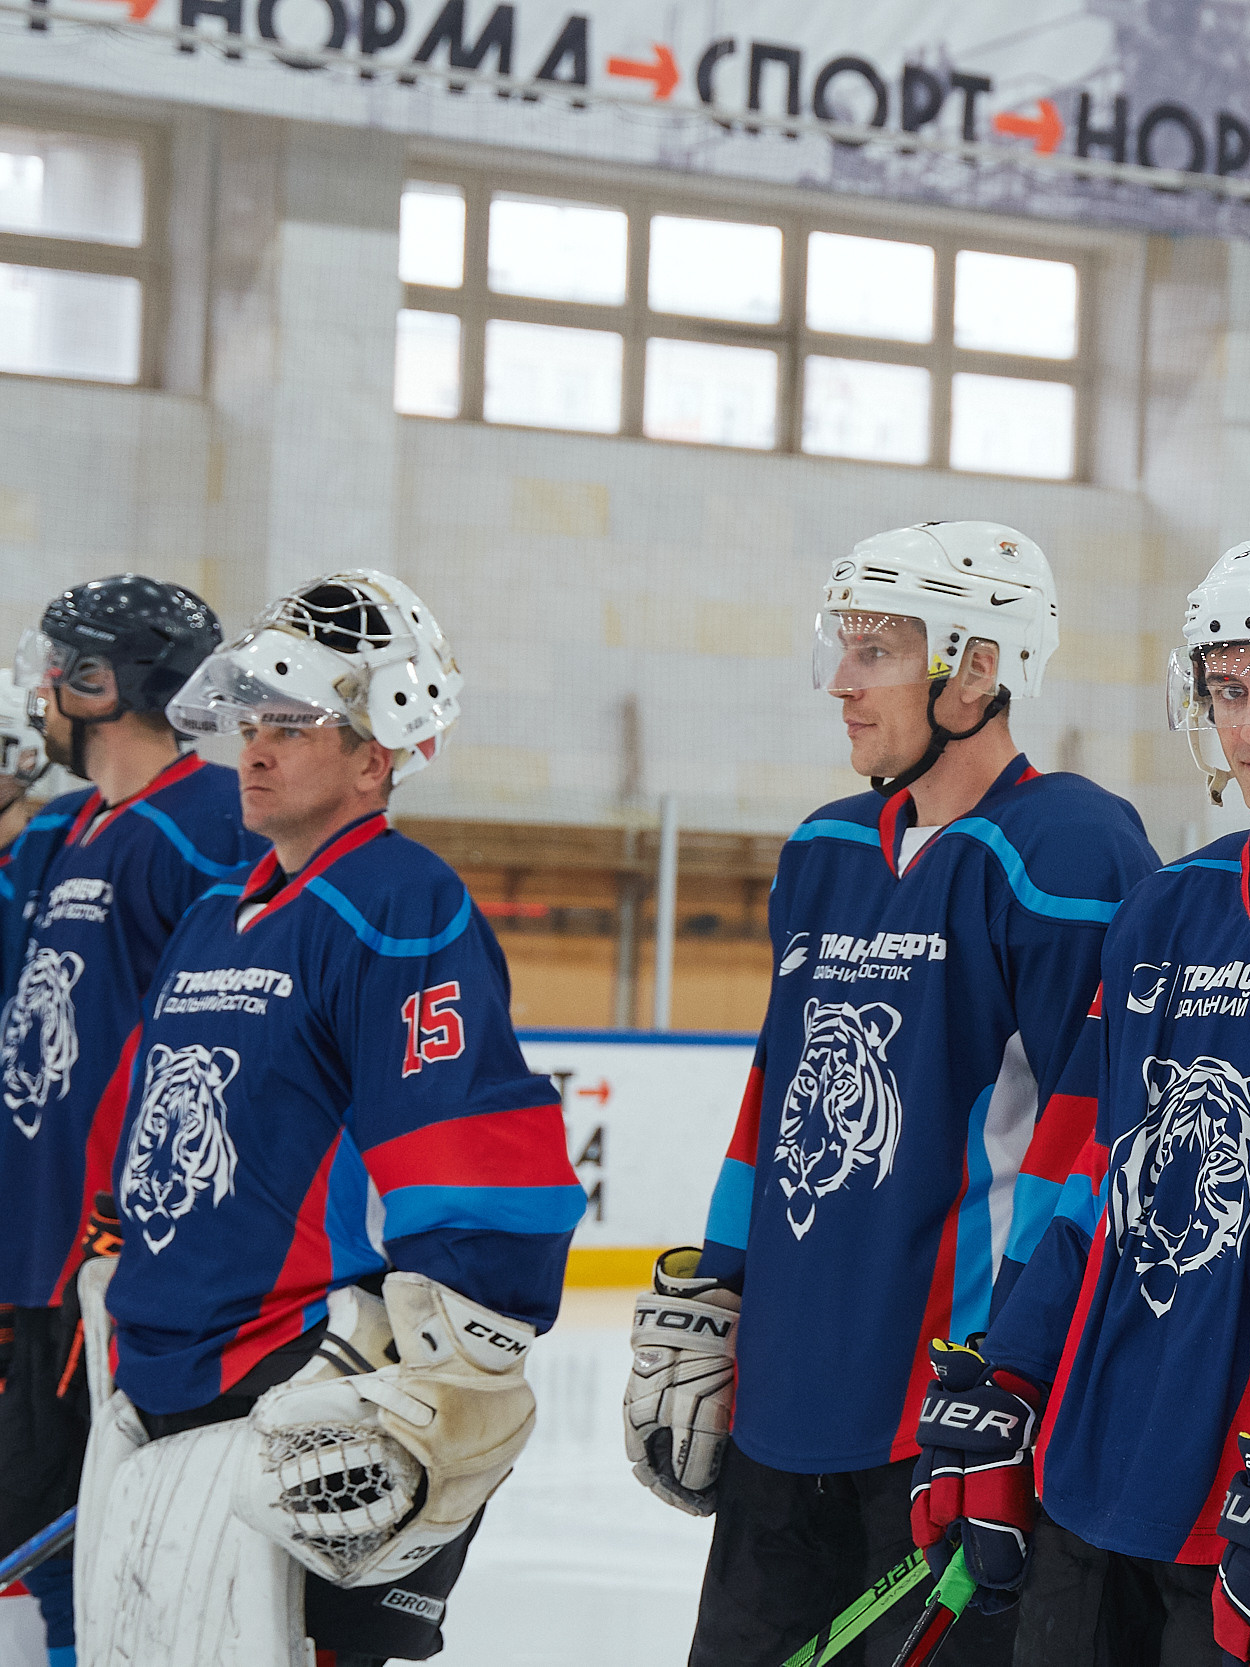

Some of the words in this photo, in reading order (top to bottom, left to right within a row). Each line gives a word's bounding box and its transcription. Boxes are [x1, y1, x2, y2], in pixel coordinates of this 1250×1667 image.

[177, 0, 592, 112] НОРМА
[696, 37, 994, 165] СПОРТ
[401, 980, 465, 1078] 15
[463, 1320, 527, 1355] CCM
